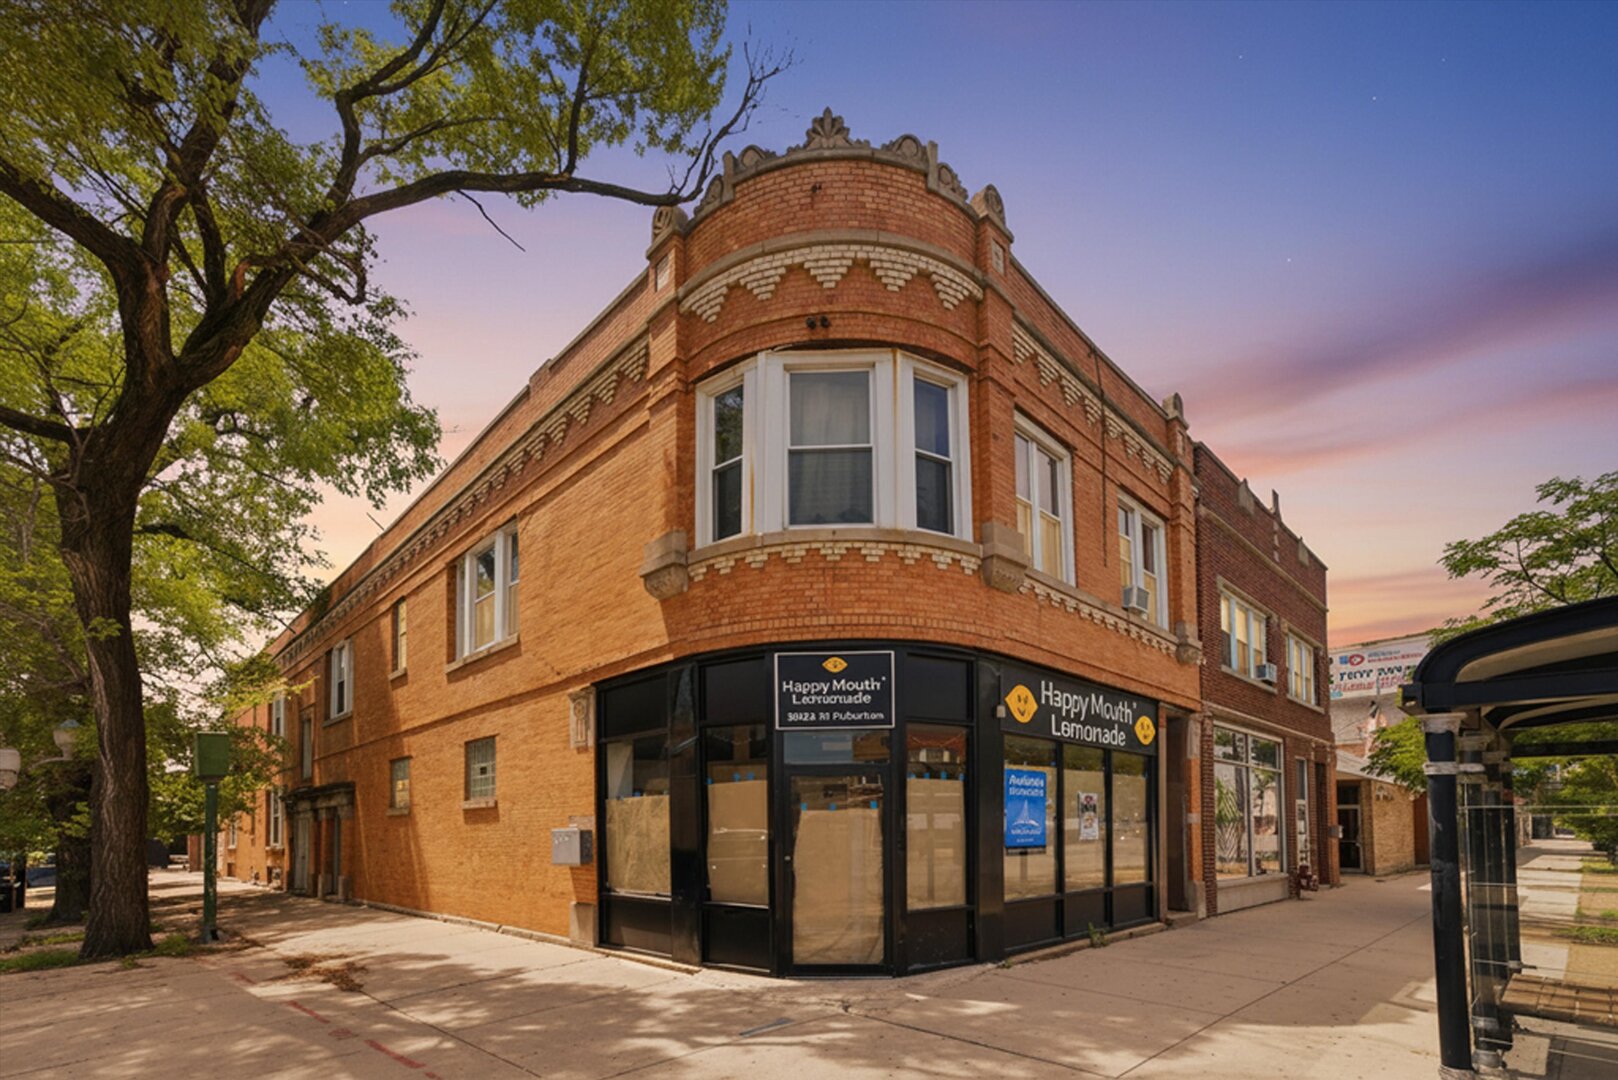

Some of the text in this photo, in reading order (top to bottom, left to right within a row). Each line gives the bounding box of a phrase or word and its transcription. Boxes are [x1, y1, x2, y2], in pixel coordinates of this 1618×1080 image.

[782, 677, 881, 694] Happy Mouth
[1040, 680, 1133, 725] Happy Mouth
[1051, 714, 1126, 746] Lemonade
